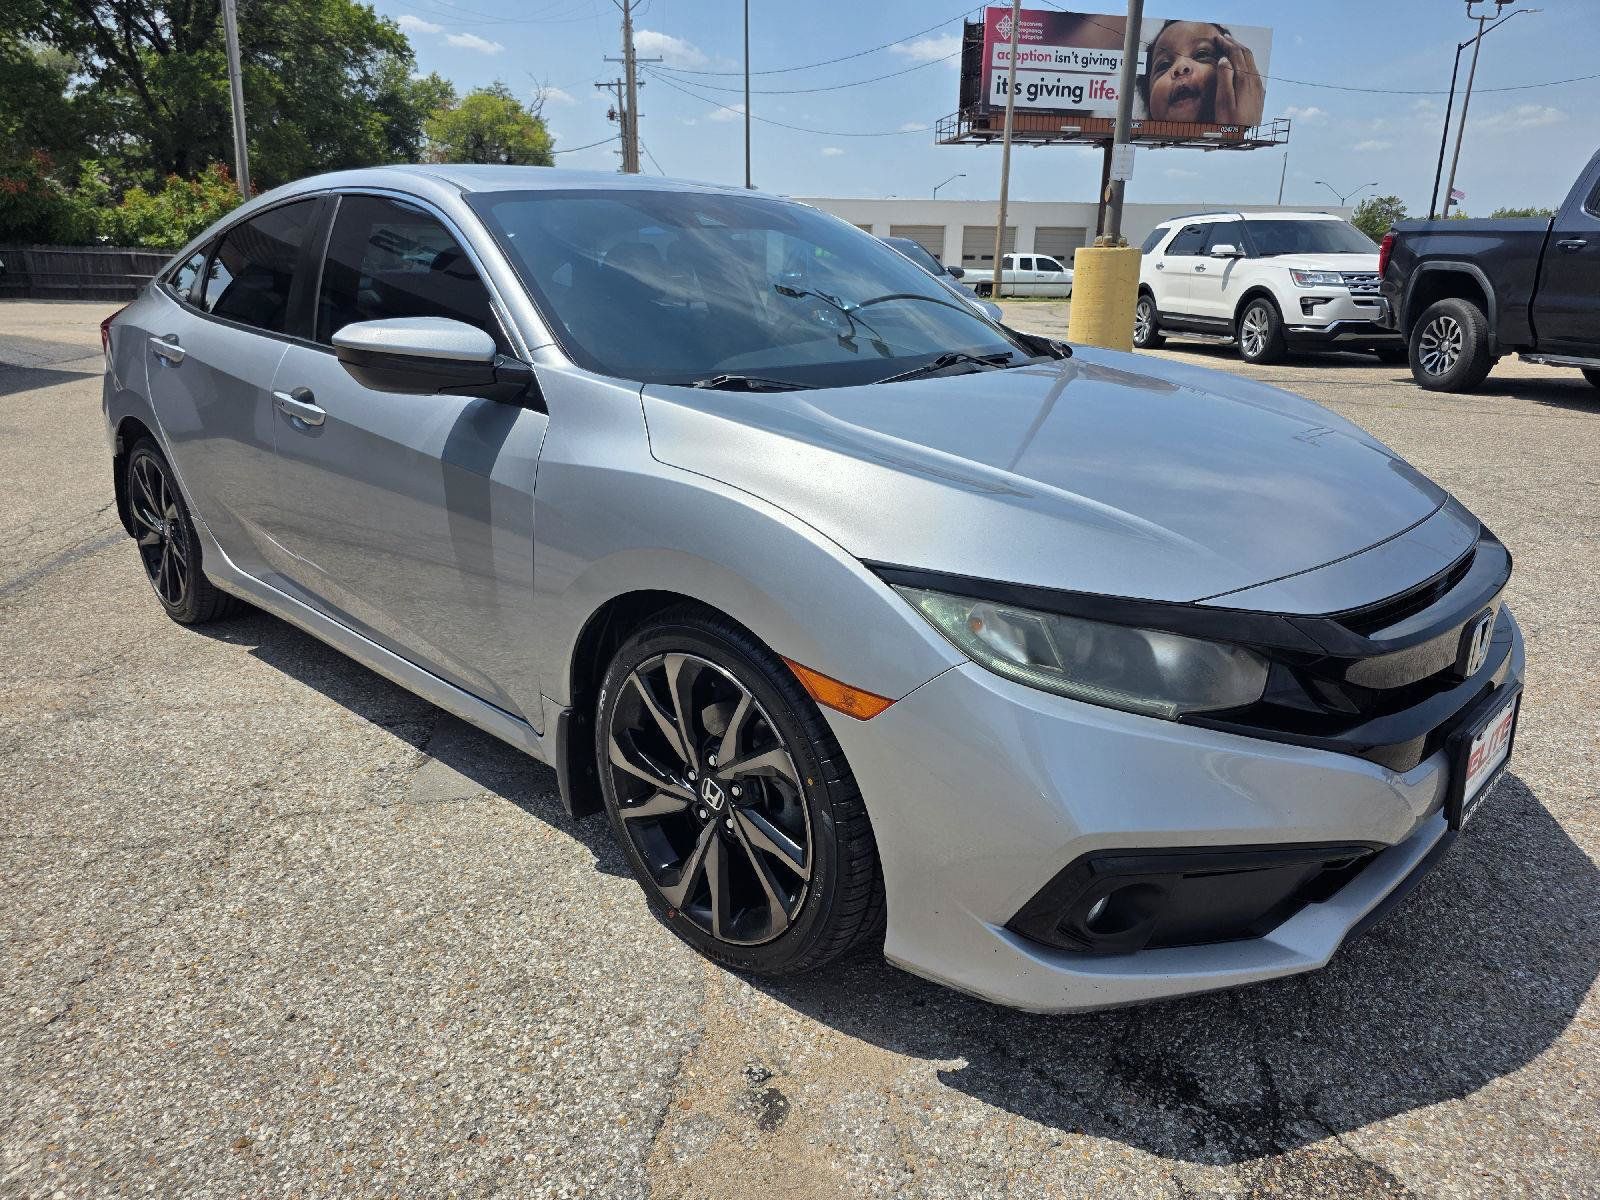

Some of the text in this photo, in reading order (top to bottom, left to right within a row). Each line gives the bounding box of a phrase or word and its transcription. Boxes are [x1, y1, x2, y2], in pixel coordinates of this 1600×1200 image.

[1055, 50, 1079, 64] isn't
[1081, 52, 1118, 70] giving
[996, 75, 1119, 104] its giving life.
